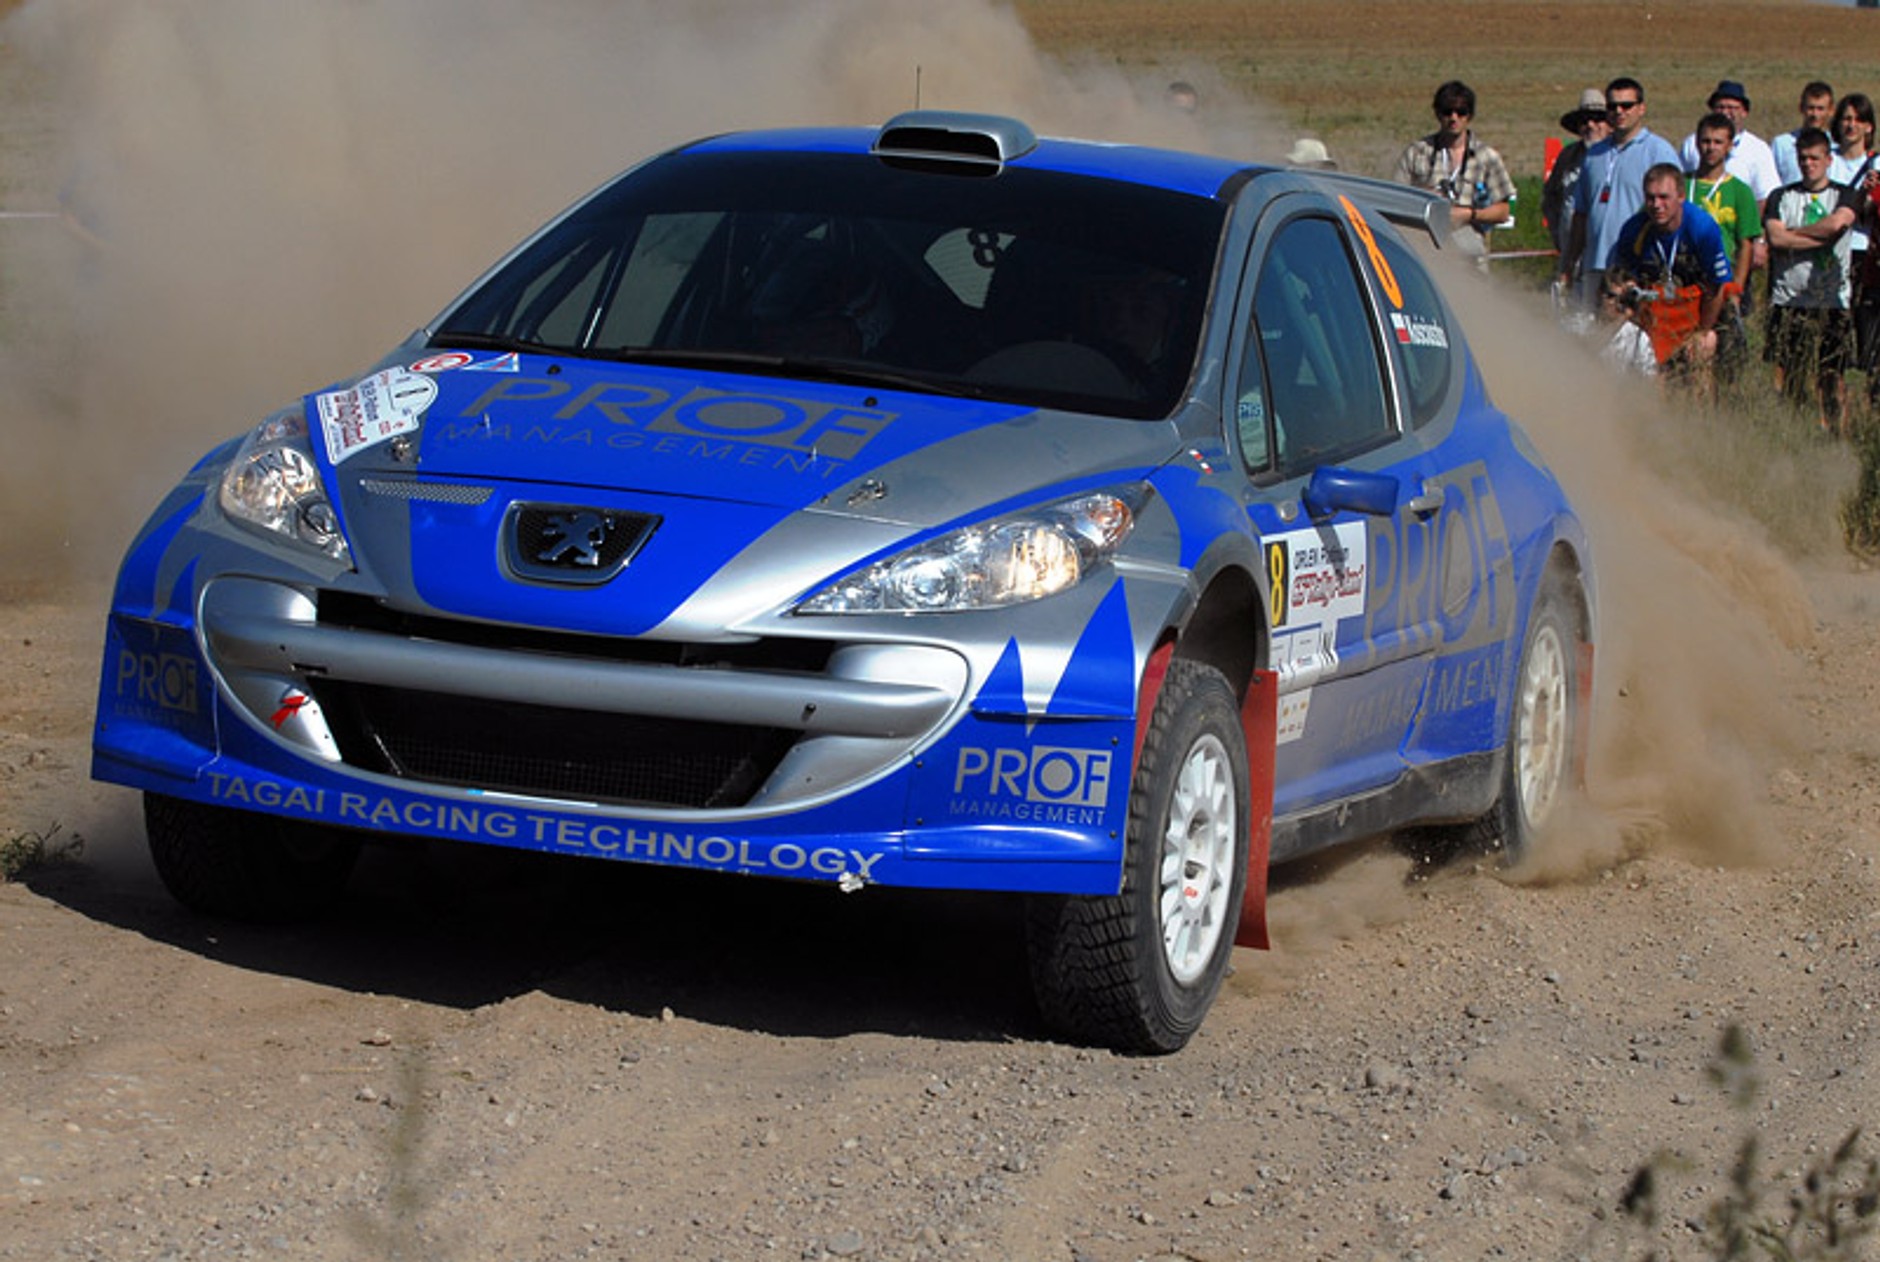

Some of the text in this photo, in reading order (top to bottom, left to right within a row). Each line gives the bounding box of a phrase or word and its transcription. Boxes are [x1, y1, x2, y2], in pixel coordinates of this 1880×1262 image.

[968, 229, 999, 268] 8
[1339, 195, 1403, 309] 8
[433, 423, 847, 479] MANAGEMENT
[459, 377, 899, 460] PROF
[1270, 543, 1285, 627] 8
[1363, 460, 1517, 664] PROF
[117, 649, 197, 713] PROF
[954, 745, 1113, 807] PROF
[207, 772, 884, 875] TAGAI RACING TECHNOLOGY
[951, 801, 1106, 826] MANAGEMENT
